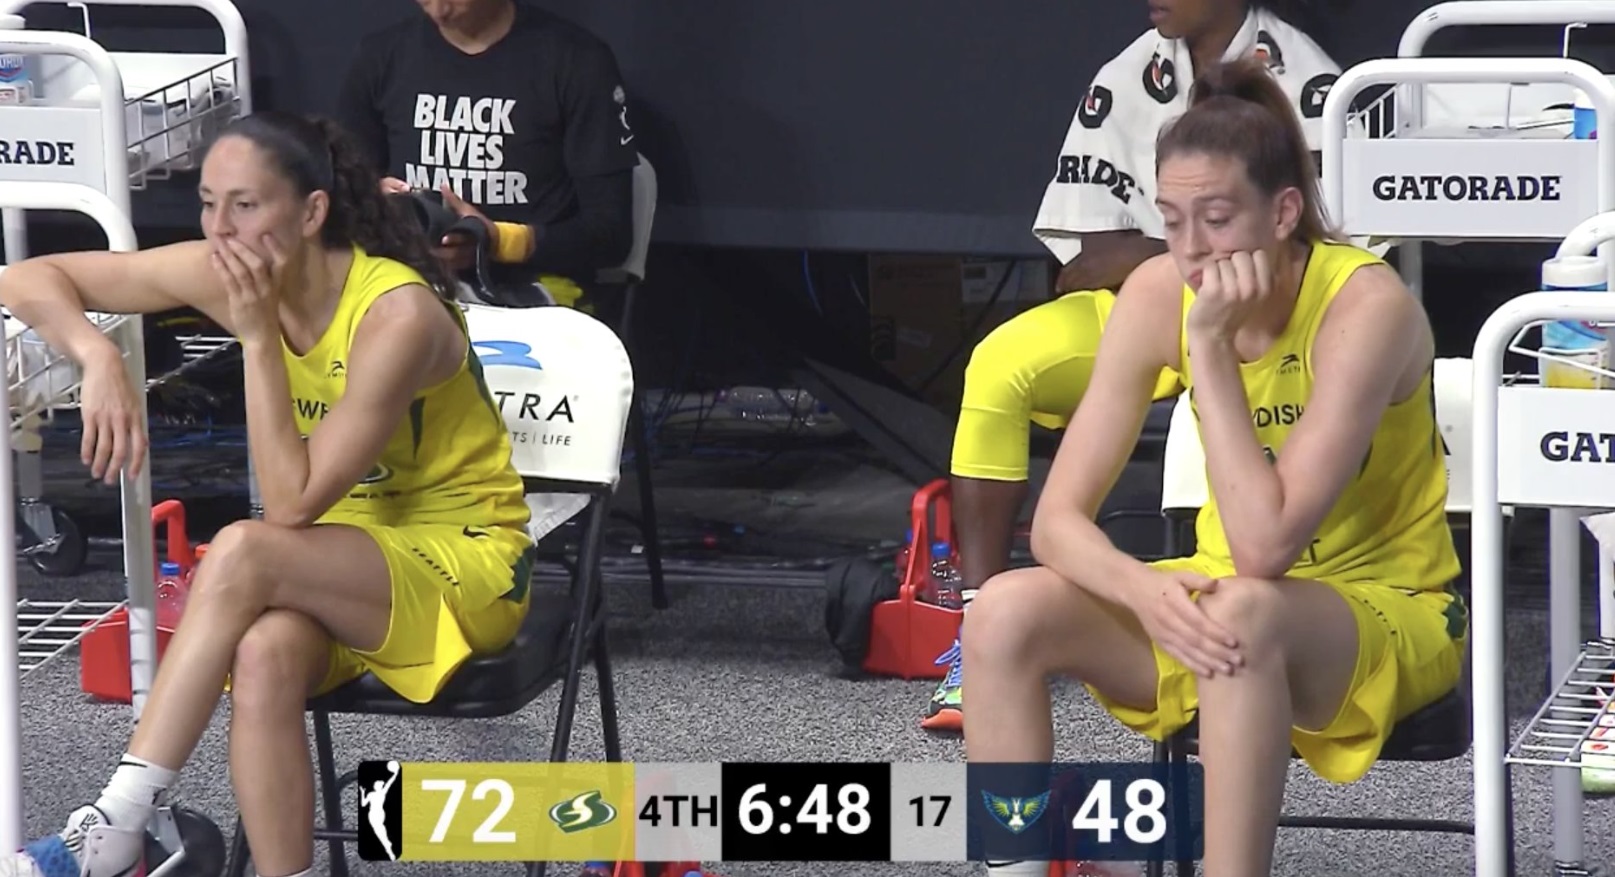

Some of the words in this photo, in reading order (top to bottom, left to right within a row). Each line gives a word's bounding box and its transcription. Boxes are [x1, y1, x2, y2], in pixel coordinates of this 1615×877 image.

[413, 93, 517, 135] BLACK
[420, 130, 504, 170] LIVES
[405, 162, 529, 205] MATTER
[1372, 175, 1562, 201] GATORADE
[1252, 403, 1305, 428] DISH
[542, 434, 572, 446] LIFE
[1539, 431, 1615, 464] GAT
